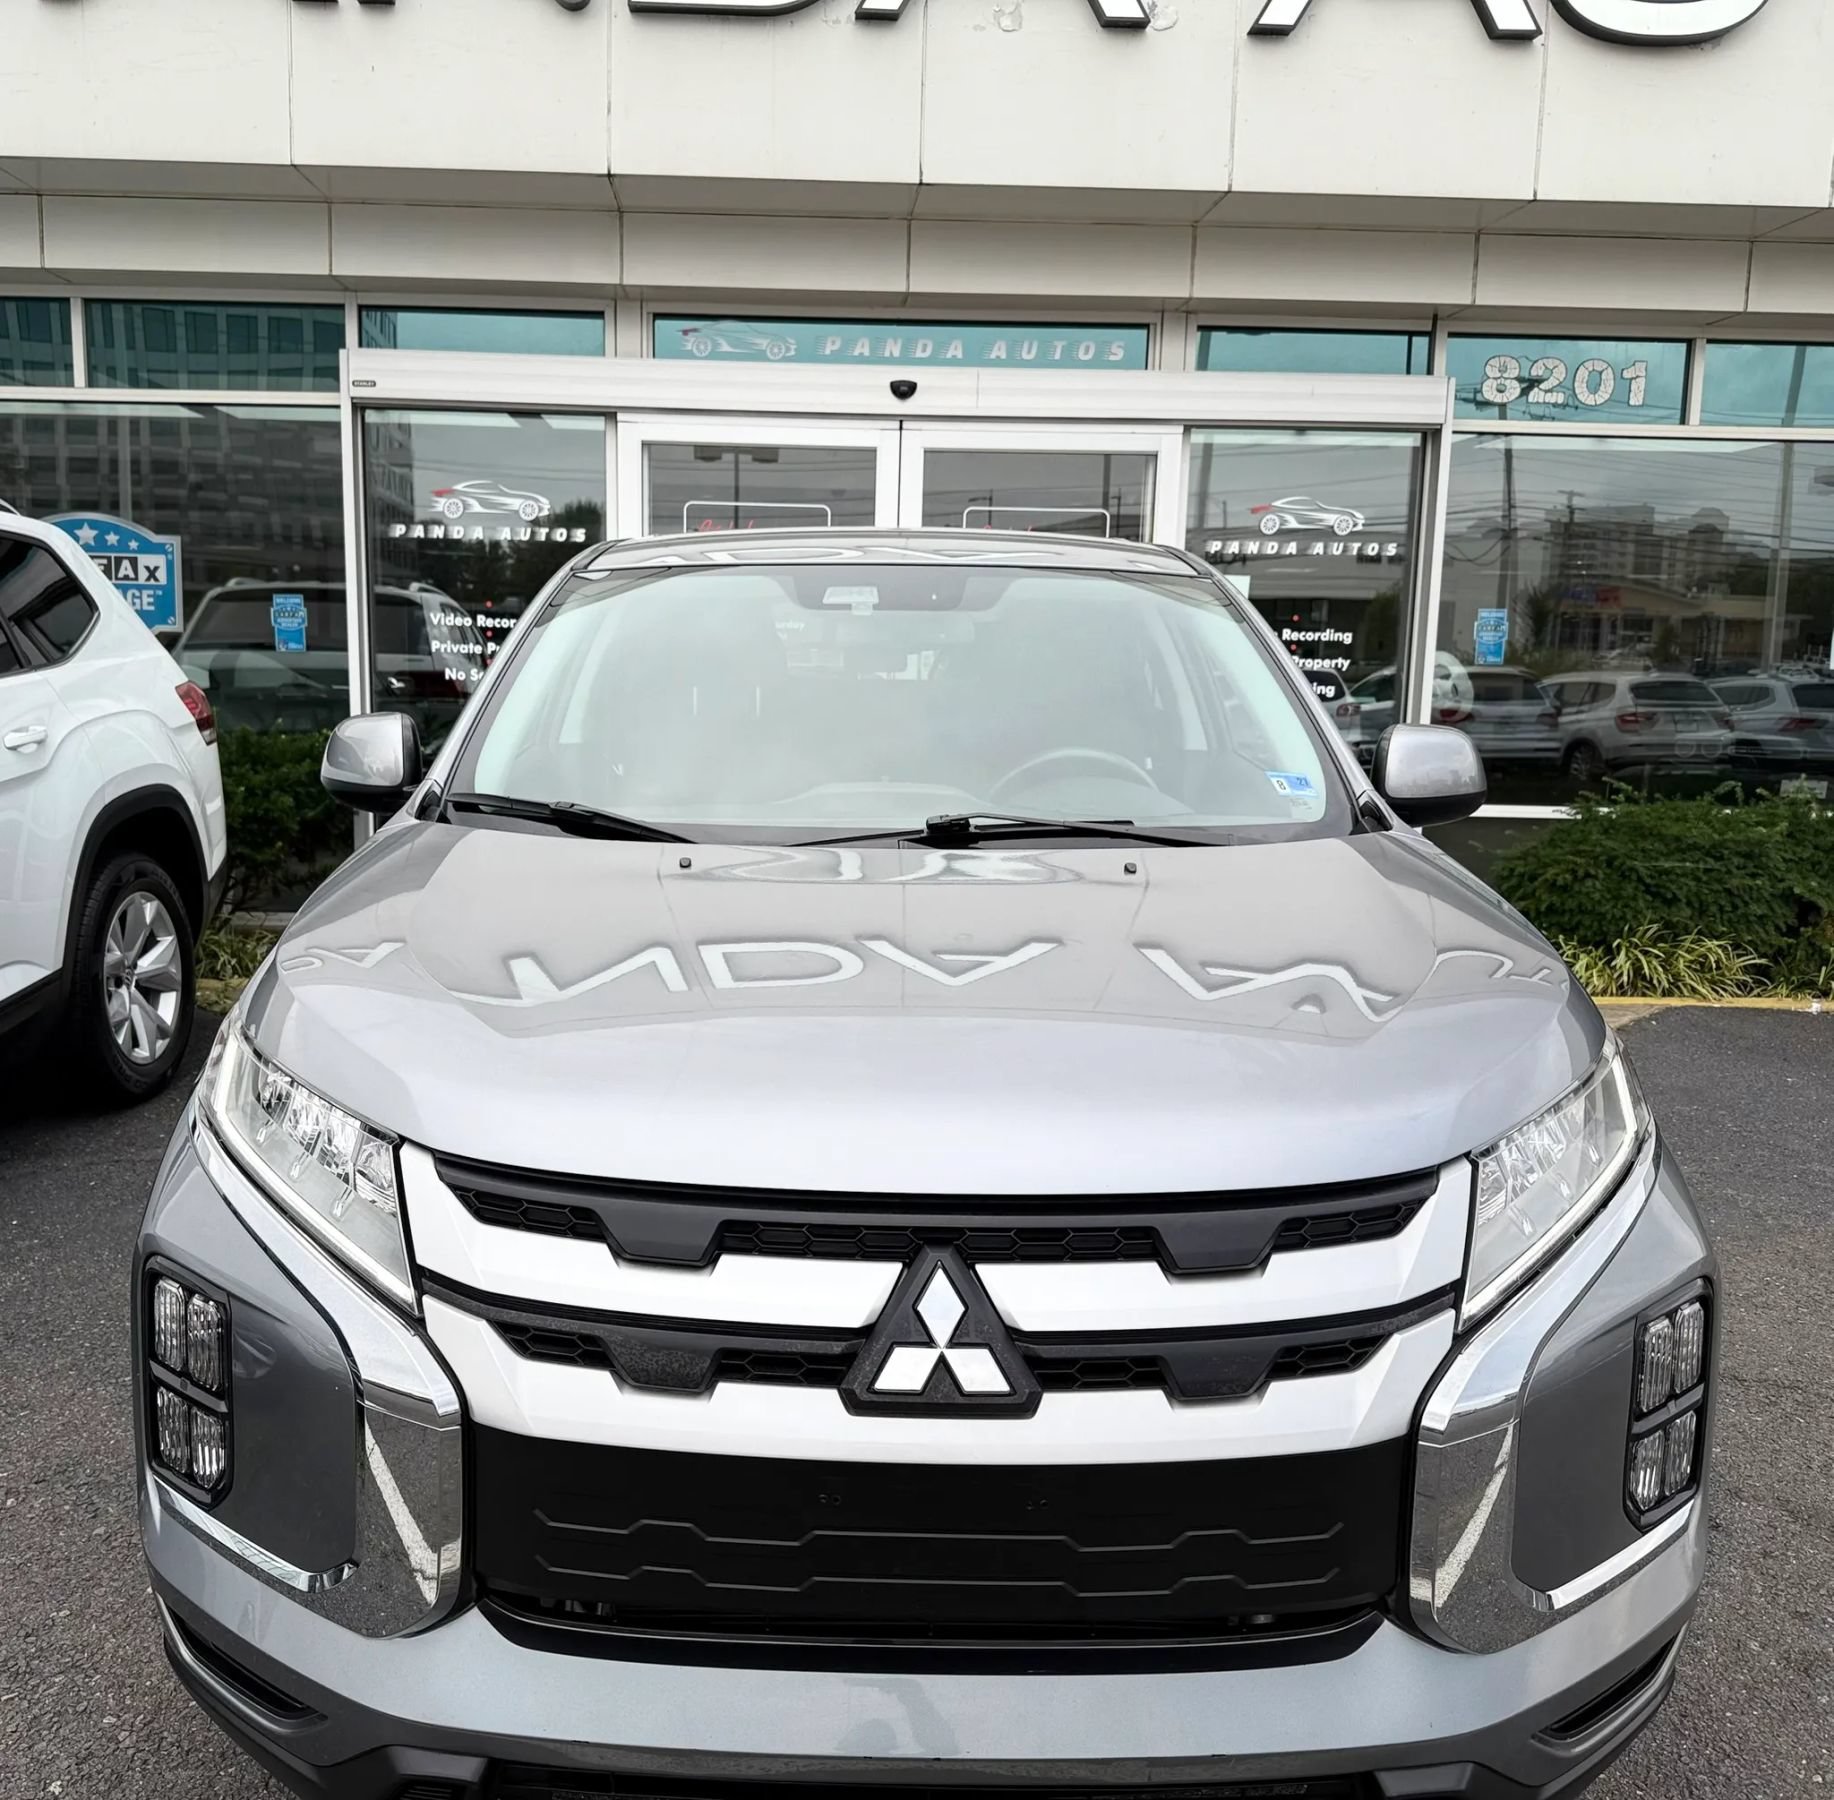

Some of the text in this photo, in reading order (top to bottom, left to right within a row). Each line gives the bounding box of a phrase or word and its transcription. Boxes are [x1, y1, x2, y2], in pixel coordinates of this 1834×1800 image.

[816, 336, 1126, 362] PANDA AUTOS
[1481, 355, 1648, 408] 8201
[389, 523, 587, 543] PANDA AUTOS
[1205, 540, 1398, 557] PANDA AUTOS
[430, 612, 473, 627] Video
[1282, 628, 1353, 644] Recording
[431, 640, 483, 654] Private
[445, 667, 466, 680] No
